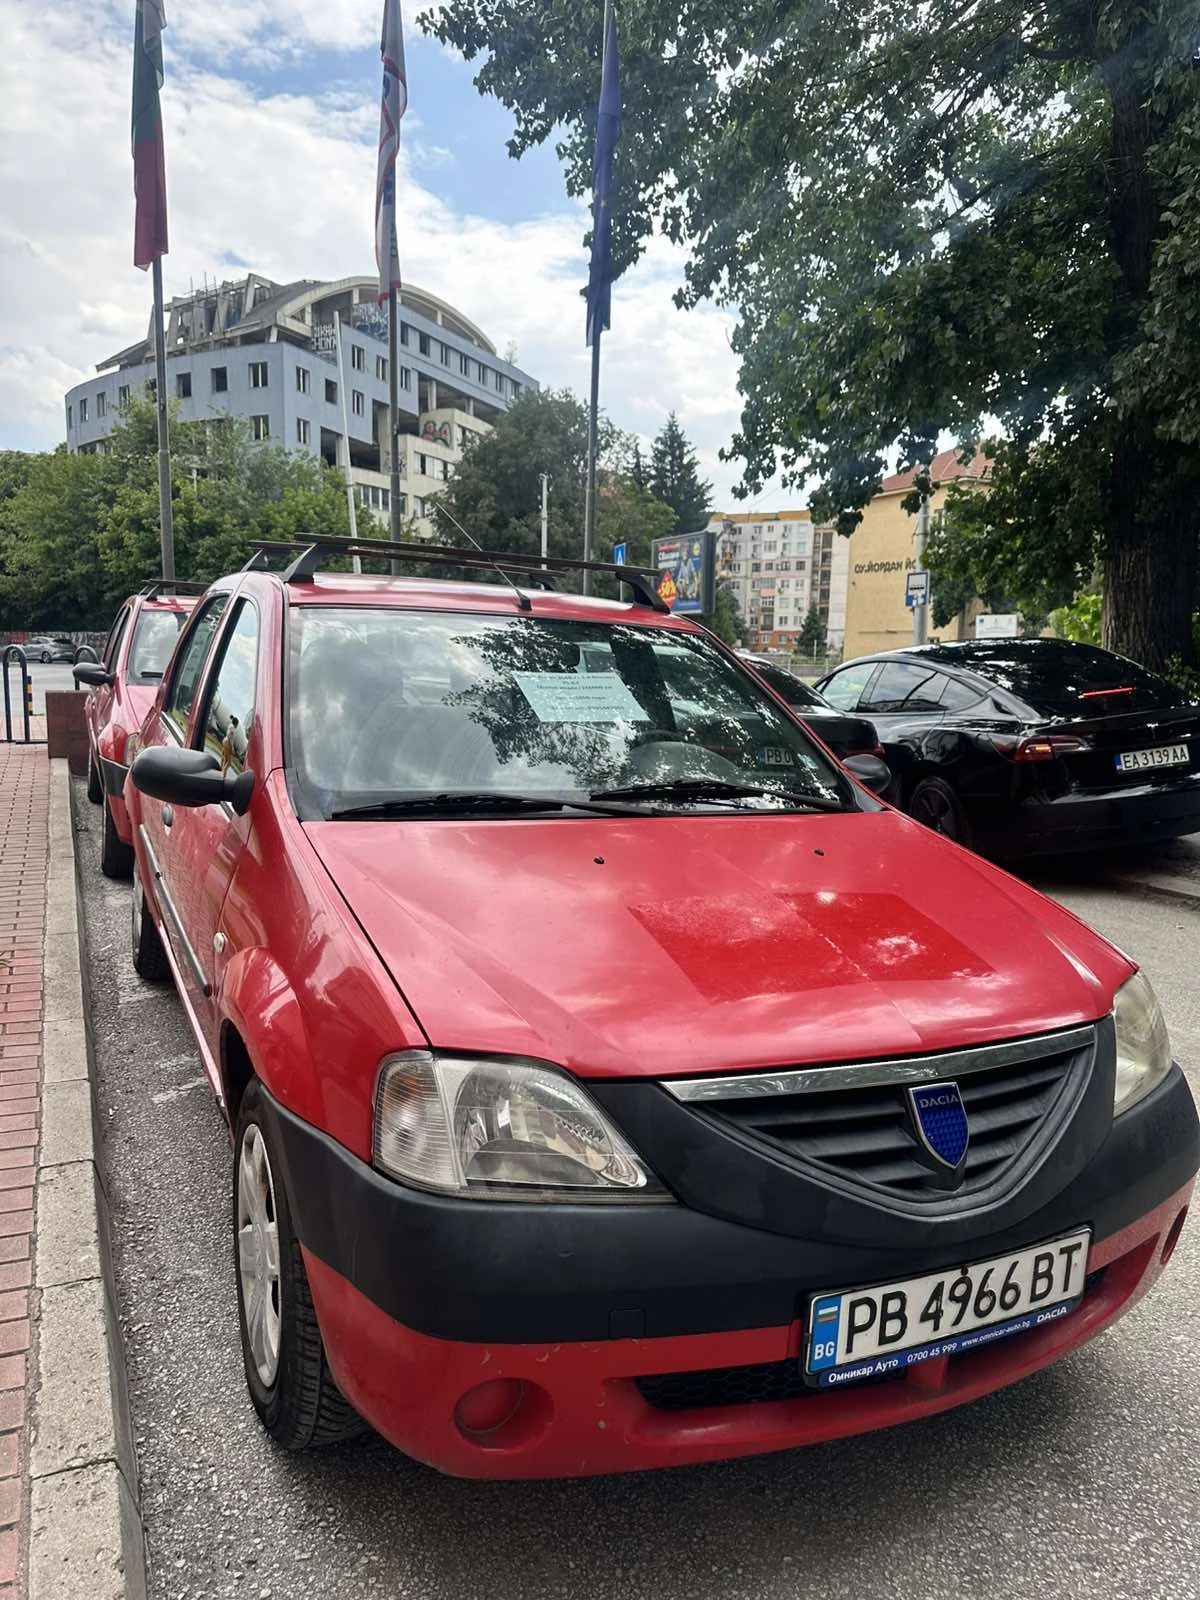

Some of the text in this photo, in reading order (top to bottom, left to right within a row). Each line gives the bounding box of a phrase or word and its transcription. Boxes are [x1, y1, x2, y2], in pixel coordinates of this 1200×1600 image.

[1122, 746, 1188, 769] EA 3139 AA
[920, 1094, 960, 1109] DACIA
[845, 1242, 1082, 1355] PB 4966 BT
[814, 1341, 836, 1361] BG
[828, 1306, 1067, 1384] Омникар Ауто 0700 45 999 www.omnicar-auto.bg DACIA
